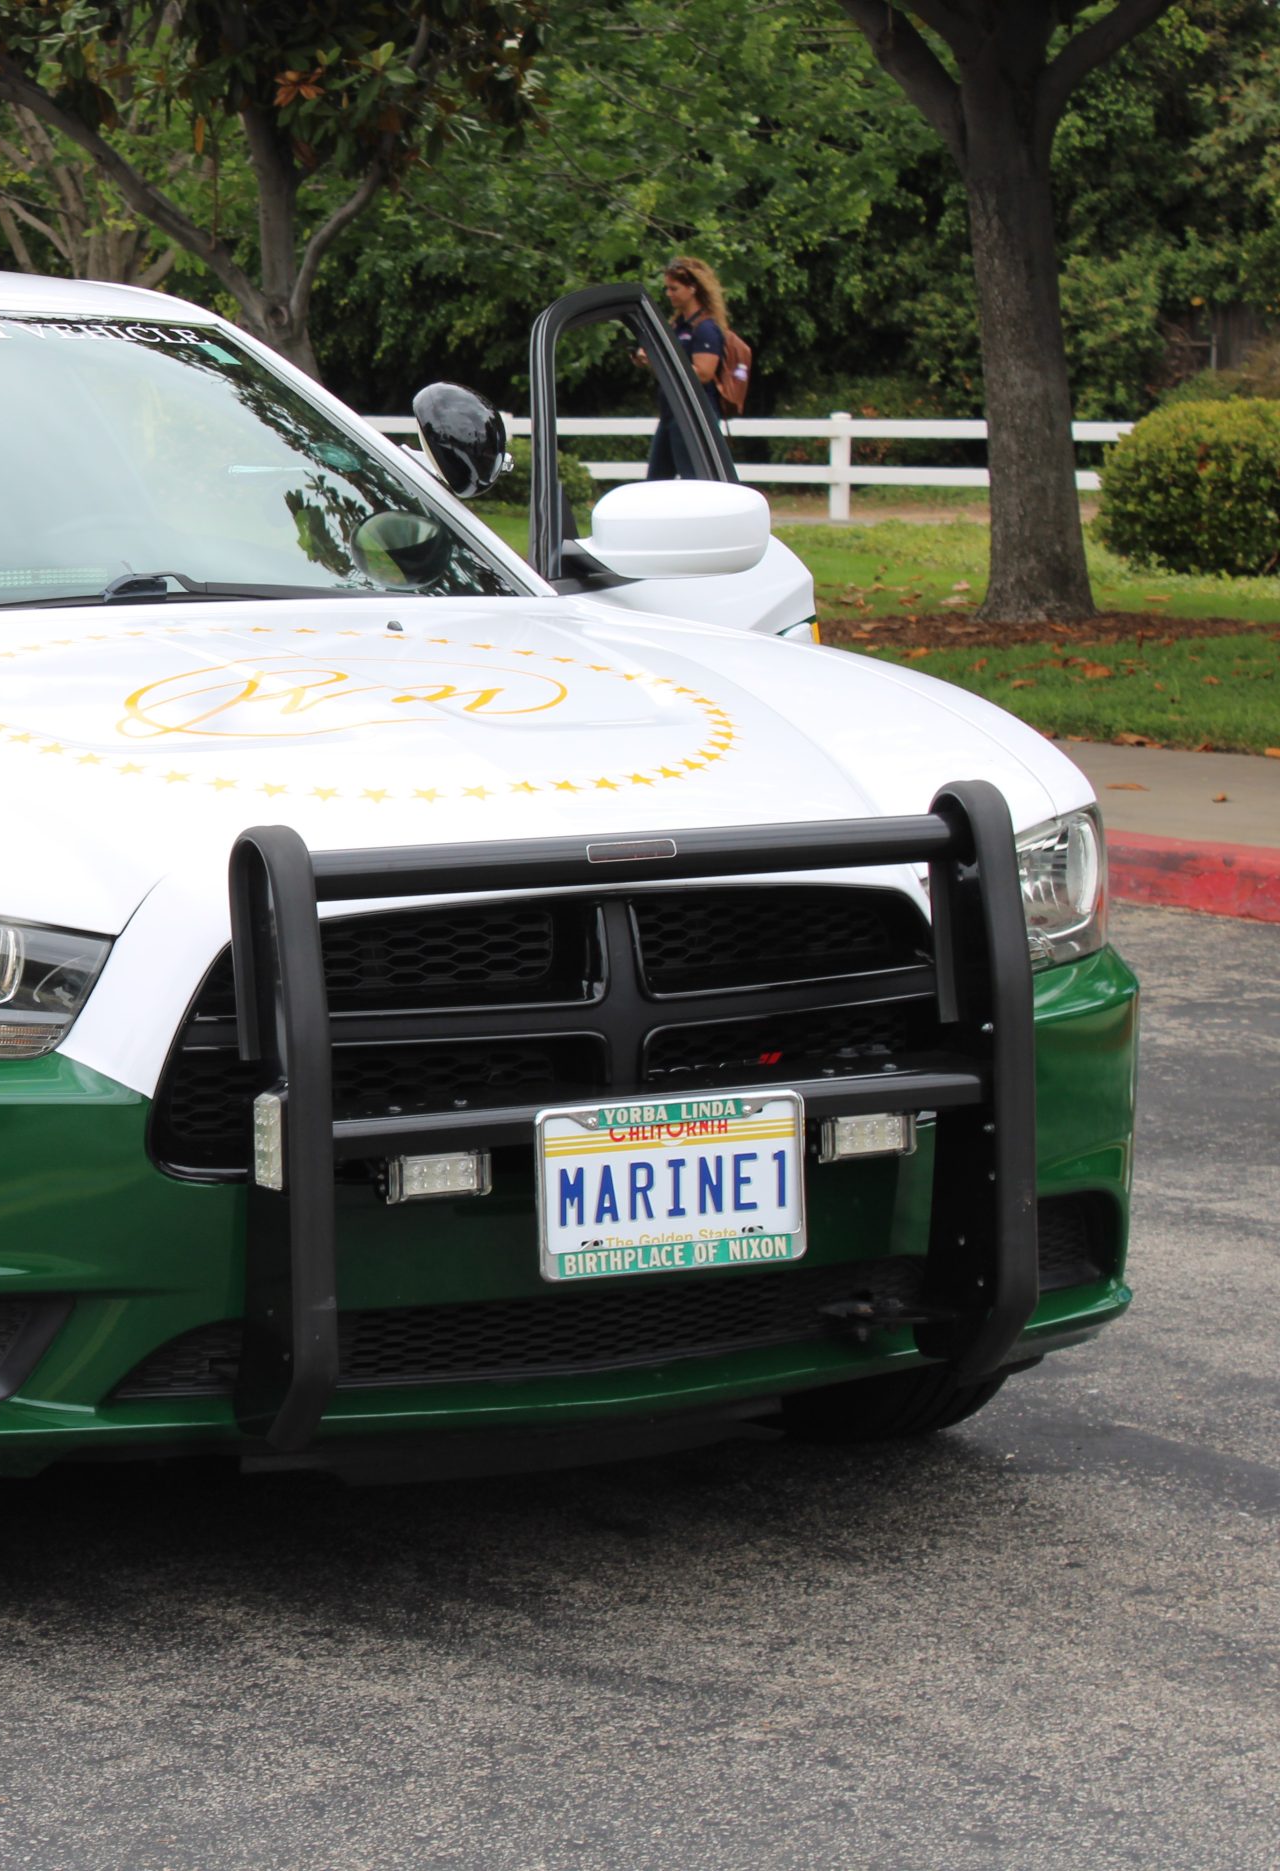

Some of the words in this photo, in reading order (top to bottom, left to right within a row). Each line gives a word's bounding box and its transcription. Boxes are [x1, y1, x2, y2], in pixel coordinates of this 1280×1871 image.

[11, 323, 212, 346] VEHICLE
[603, 1105, 668, 1125] YORBA
[680, 1100, 736, 1120] LINDA
[559, 1150, 787, 1227] MARINE1
[606, 1236, 635, 1248] The
[698, 1228, 737, 1240] State
[564, 1244, 684, 1276] BIRTHPLACE
[694, 1242, 718, 1263] OF
[729, 1236, 787, 1260] NIXON
